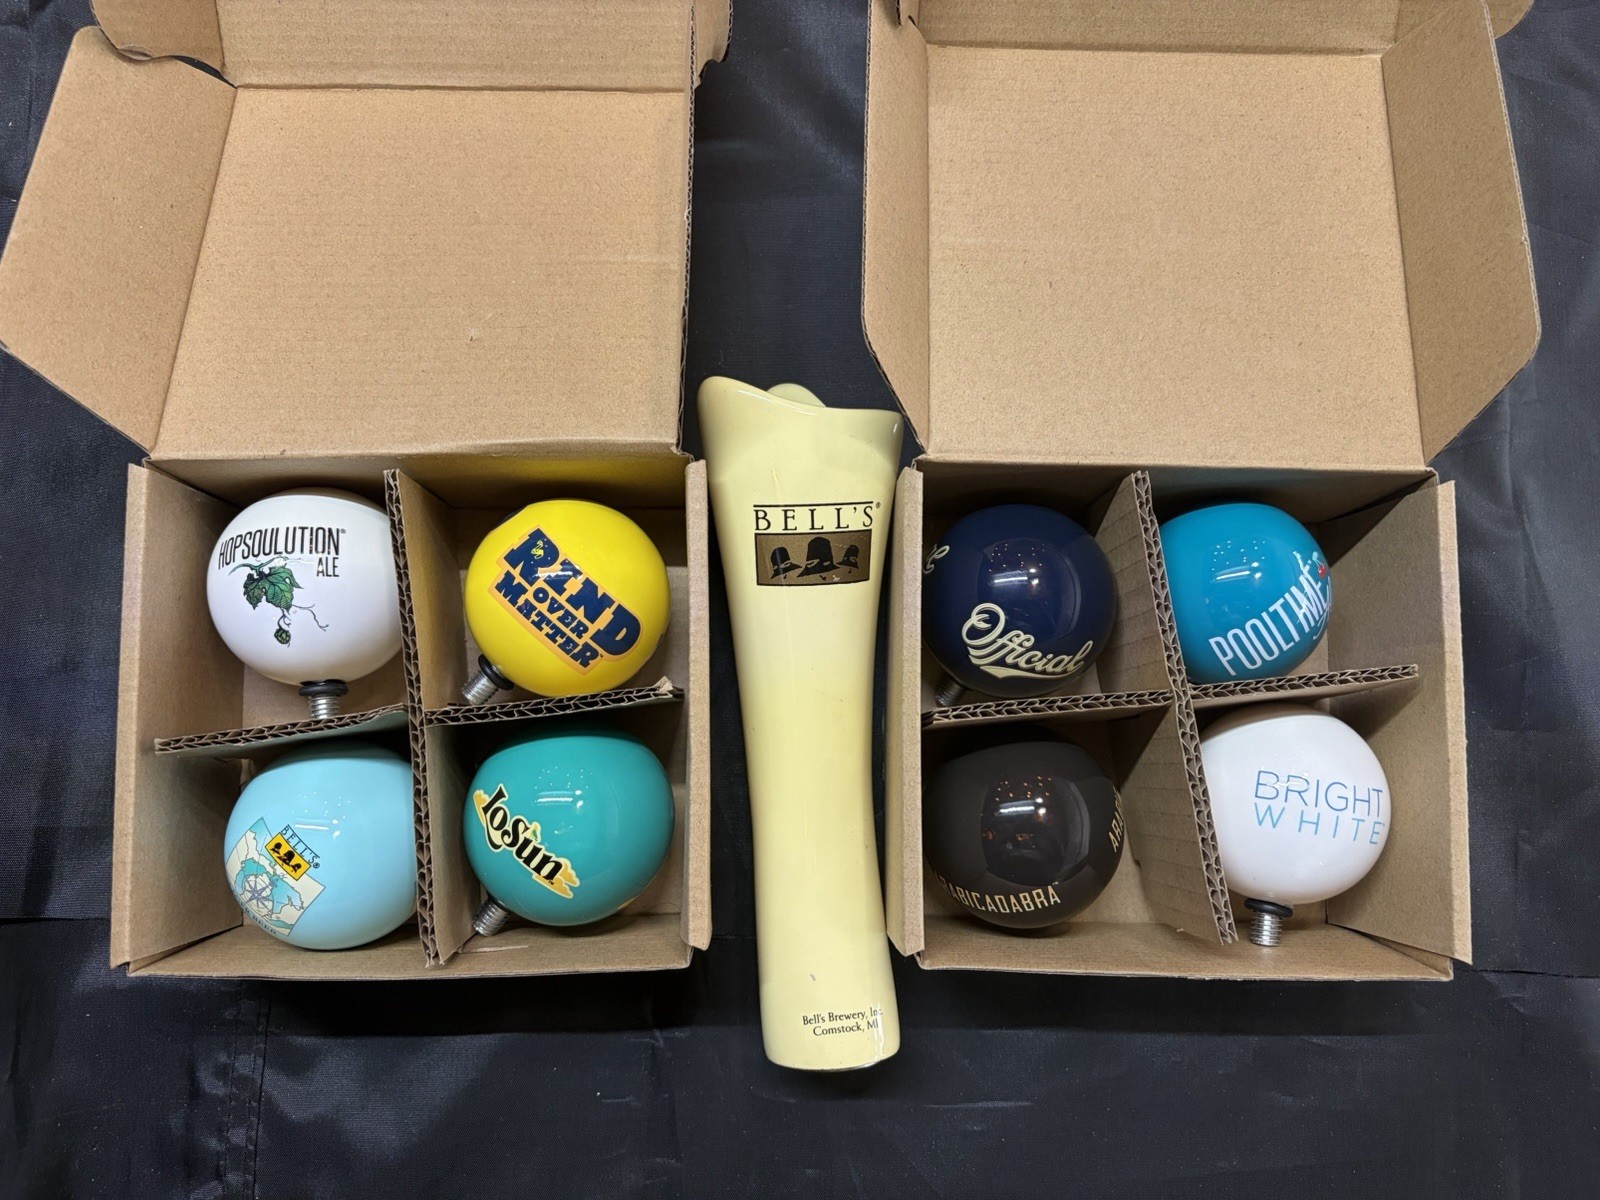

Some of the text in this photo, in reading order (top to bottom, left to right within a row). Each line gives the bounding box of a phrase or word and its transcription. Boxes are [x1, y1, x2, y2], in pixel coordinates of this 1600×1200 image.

[753, 505, 873, 531] BELL'S
[218, 526, 340, 570] HOPSOULUTION
[316, 556, 340, 577] ALE
[503, 527, 641, 656] RIND
[532, 586, 590, 639] OVER
[494, 569, 600, 669] MATTER
[961, 602, 1094, 678] Official
[1254, 770, 1383, 818] BRIGHT
[280, 825, 319, 865] BELL'S
[1254, 802, 1383, 845] WHITE
[802, 1013, 826, 1026] Bell's
[828, 1010, 868, 1022] Brewery,
[812, 1018, 879, 1037] Comstock, MI
